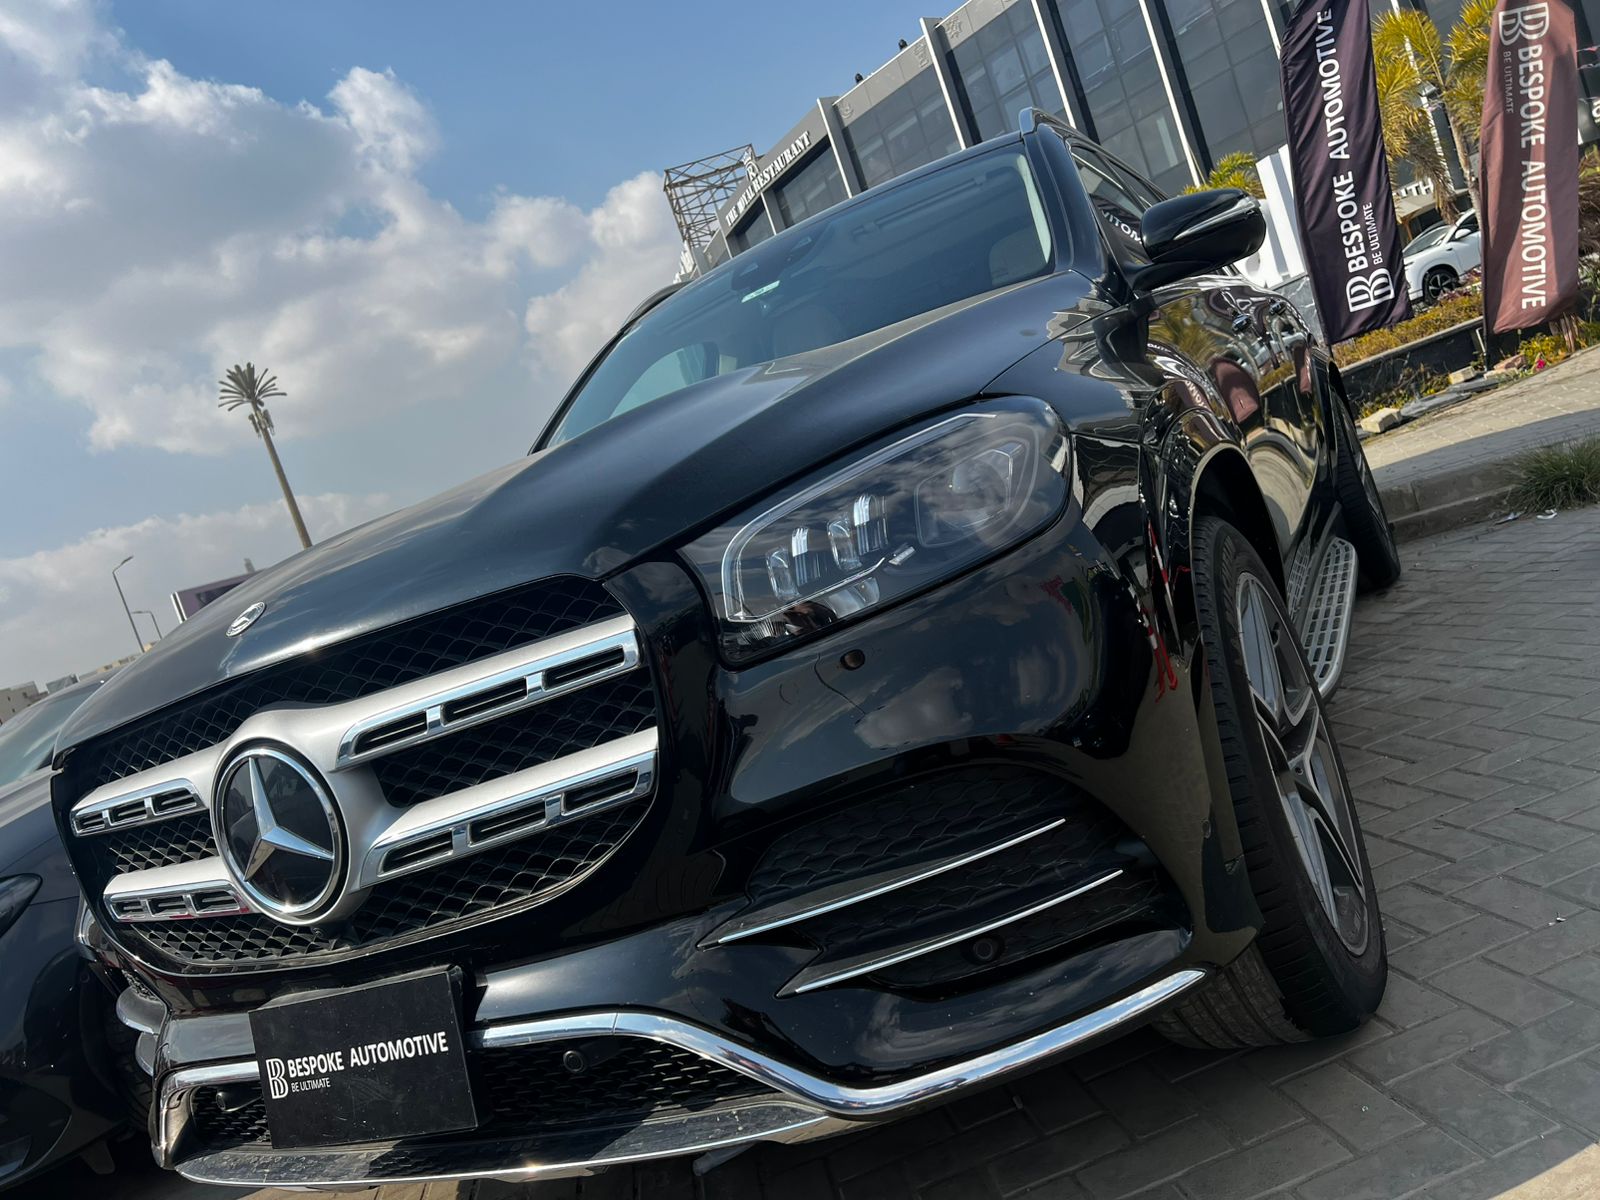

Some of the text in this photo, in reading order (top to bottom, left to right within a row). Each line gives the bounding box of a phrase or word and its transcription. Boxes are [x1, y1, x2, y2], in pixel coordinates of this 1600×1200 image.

[1503, 51, 1514, 113] BE ULTIMATE
[1315, 8, 1368, 273] BESPOKE AUTOMOTIVE
[725, 205, 738, 226] THE
[752, 131, 810, 193] RESTAURANT
[1518, 44, 1546, 309] BESPOKE AUTOMOTIVE
[1363, 202, 1383, 265] BE ULTIMATE
[287, 1031, 449, 1078] BESPOKE AUTOMOTIVE
[291, 1077, 331, 1092] BE ULTIMATE
